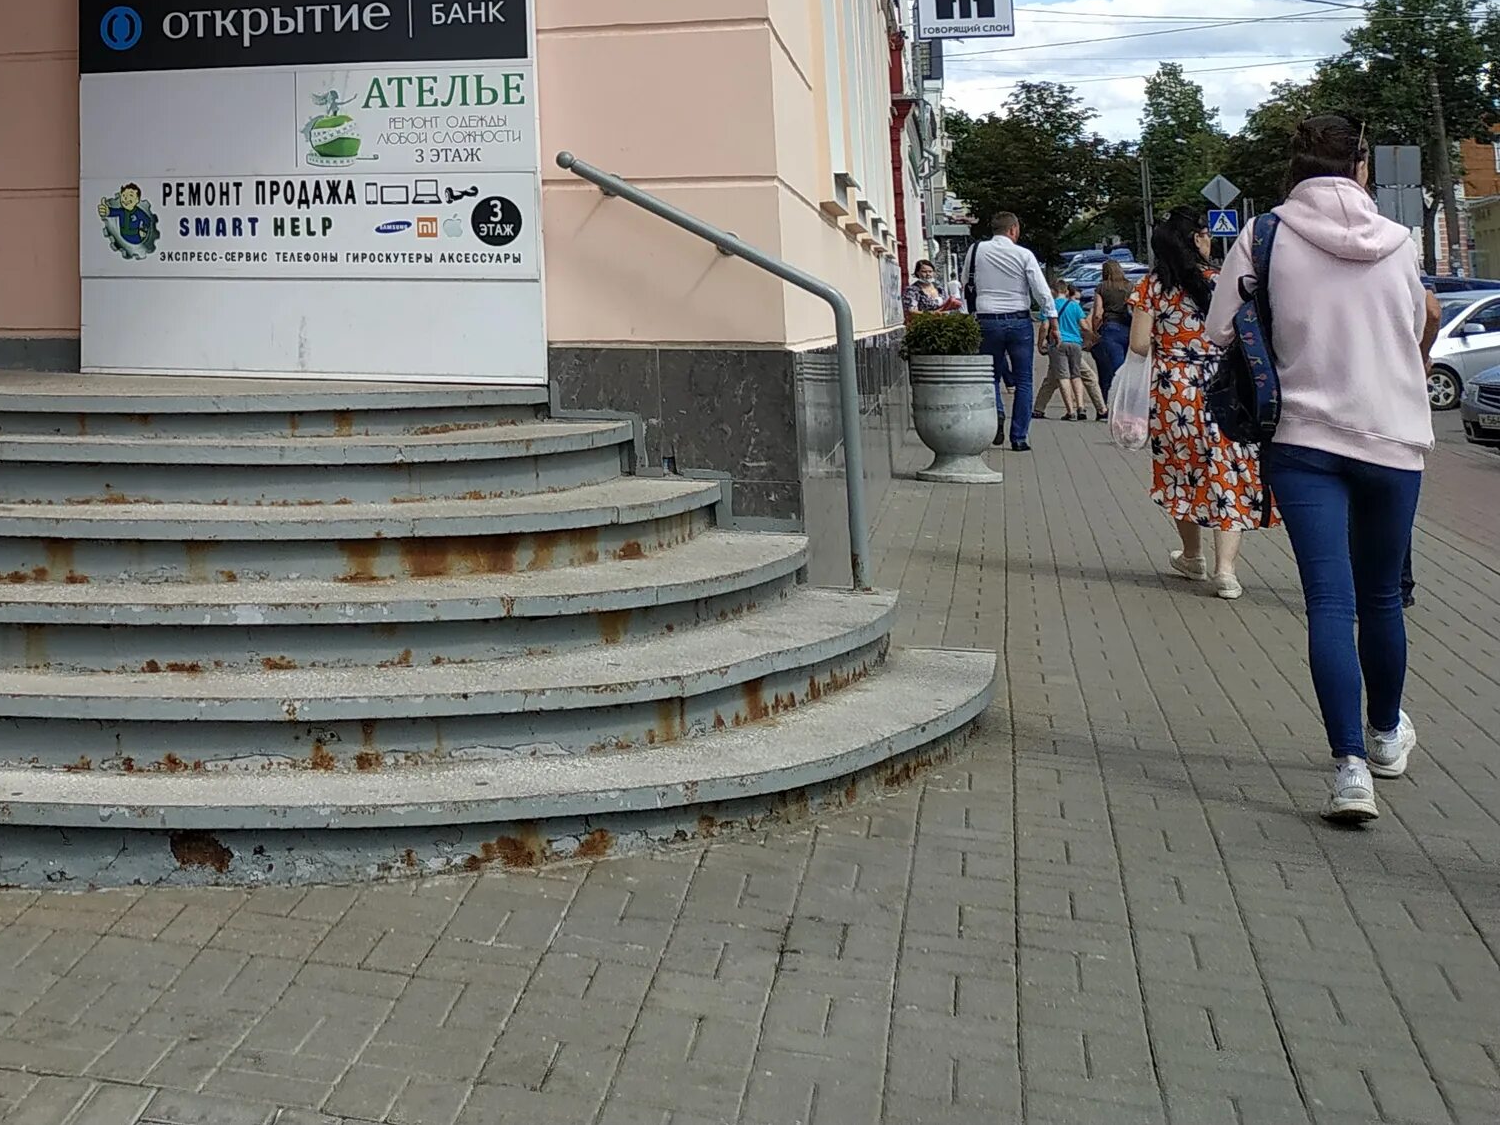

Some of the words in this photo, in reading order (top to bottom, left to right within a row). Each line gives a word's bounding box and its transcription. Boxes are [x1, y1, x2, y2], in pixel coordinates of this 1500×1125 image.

[161, 0, 392, 48] открытие
[431, 0, 506, 26] БАНК
[923, 23, 981, 34] ГОВОРЯЩИЙ
[983, 23, 1010, 32] СЛОН
[361, 73, 526, 109] АТЕЛЬЕ
[388, 115, 440, 129] РЕМОНТ
[446, 114, 507, 128] ОДЕЖДЫ
[377, 131, 428, 145] ЛЮБОЙ
[432, 129, 522, 144] СЛОЖНОСТИ
[414, 148, 425, 163] 3
[429, 147, 482, 163] ЭТАЖ
[161, 182, 243, 207] РЕМОНТ
[255, 180, 357, 209] ПРОДАЖА
[489, 199, 503, 222] 3
[179, 217, 259, 237] SMART
[273, 217, 333, 237] HELP
[379, 223, 408, 231] SAMSUNG
[478, 224, 514, 236] ЭТАЖ
[159, 251, 268, 263] ЭКСПРЕСС-СЕРВИС
[275, 251, 339, 263] ТЕЛЕФОНЫ
[345, 252, 433, 264] ГИРОСКУТЕРЫ
[439, 252, 522, 264] АКСЕССУАРЫ
